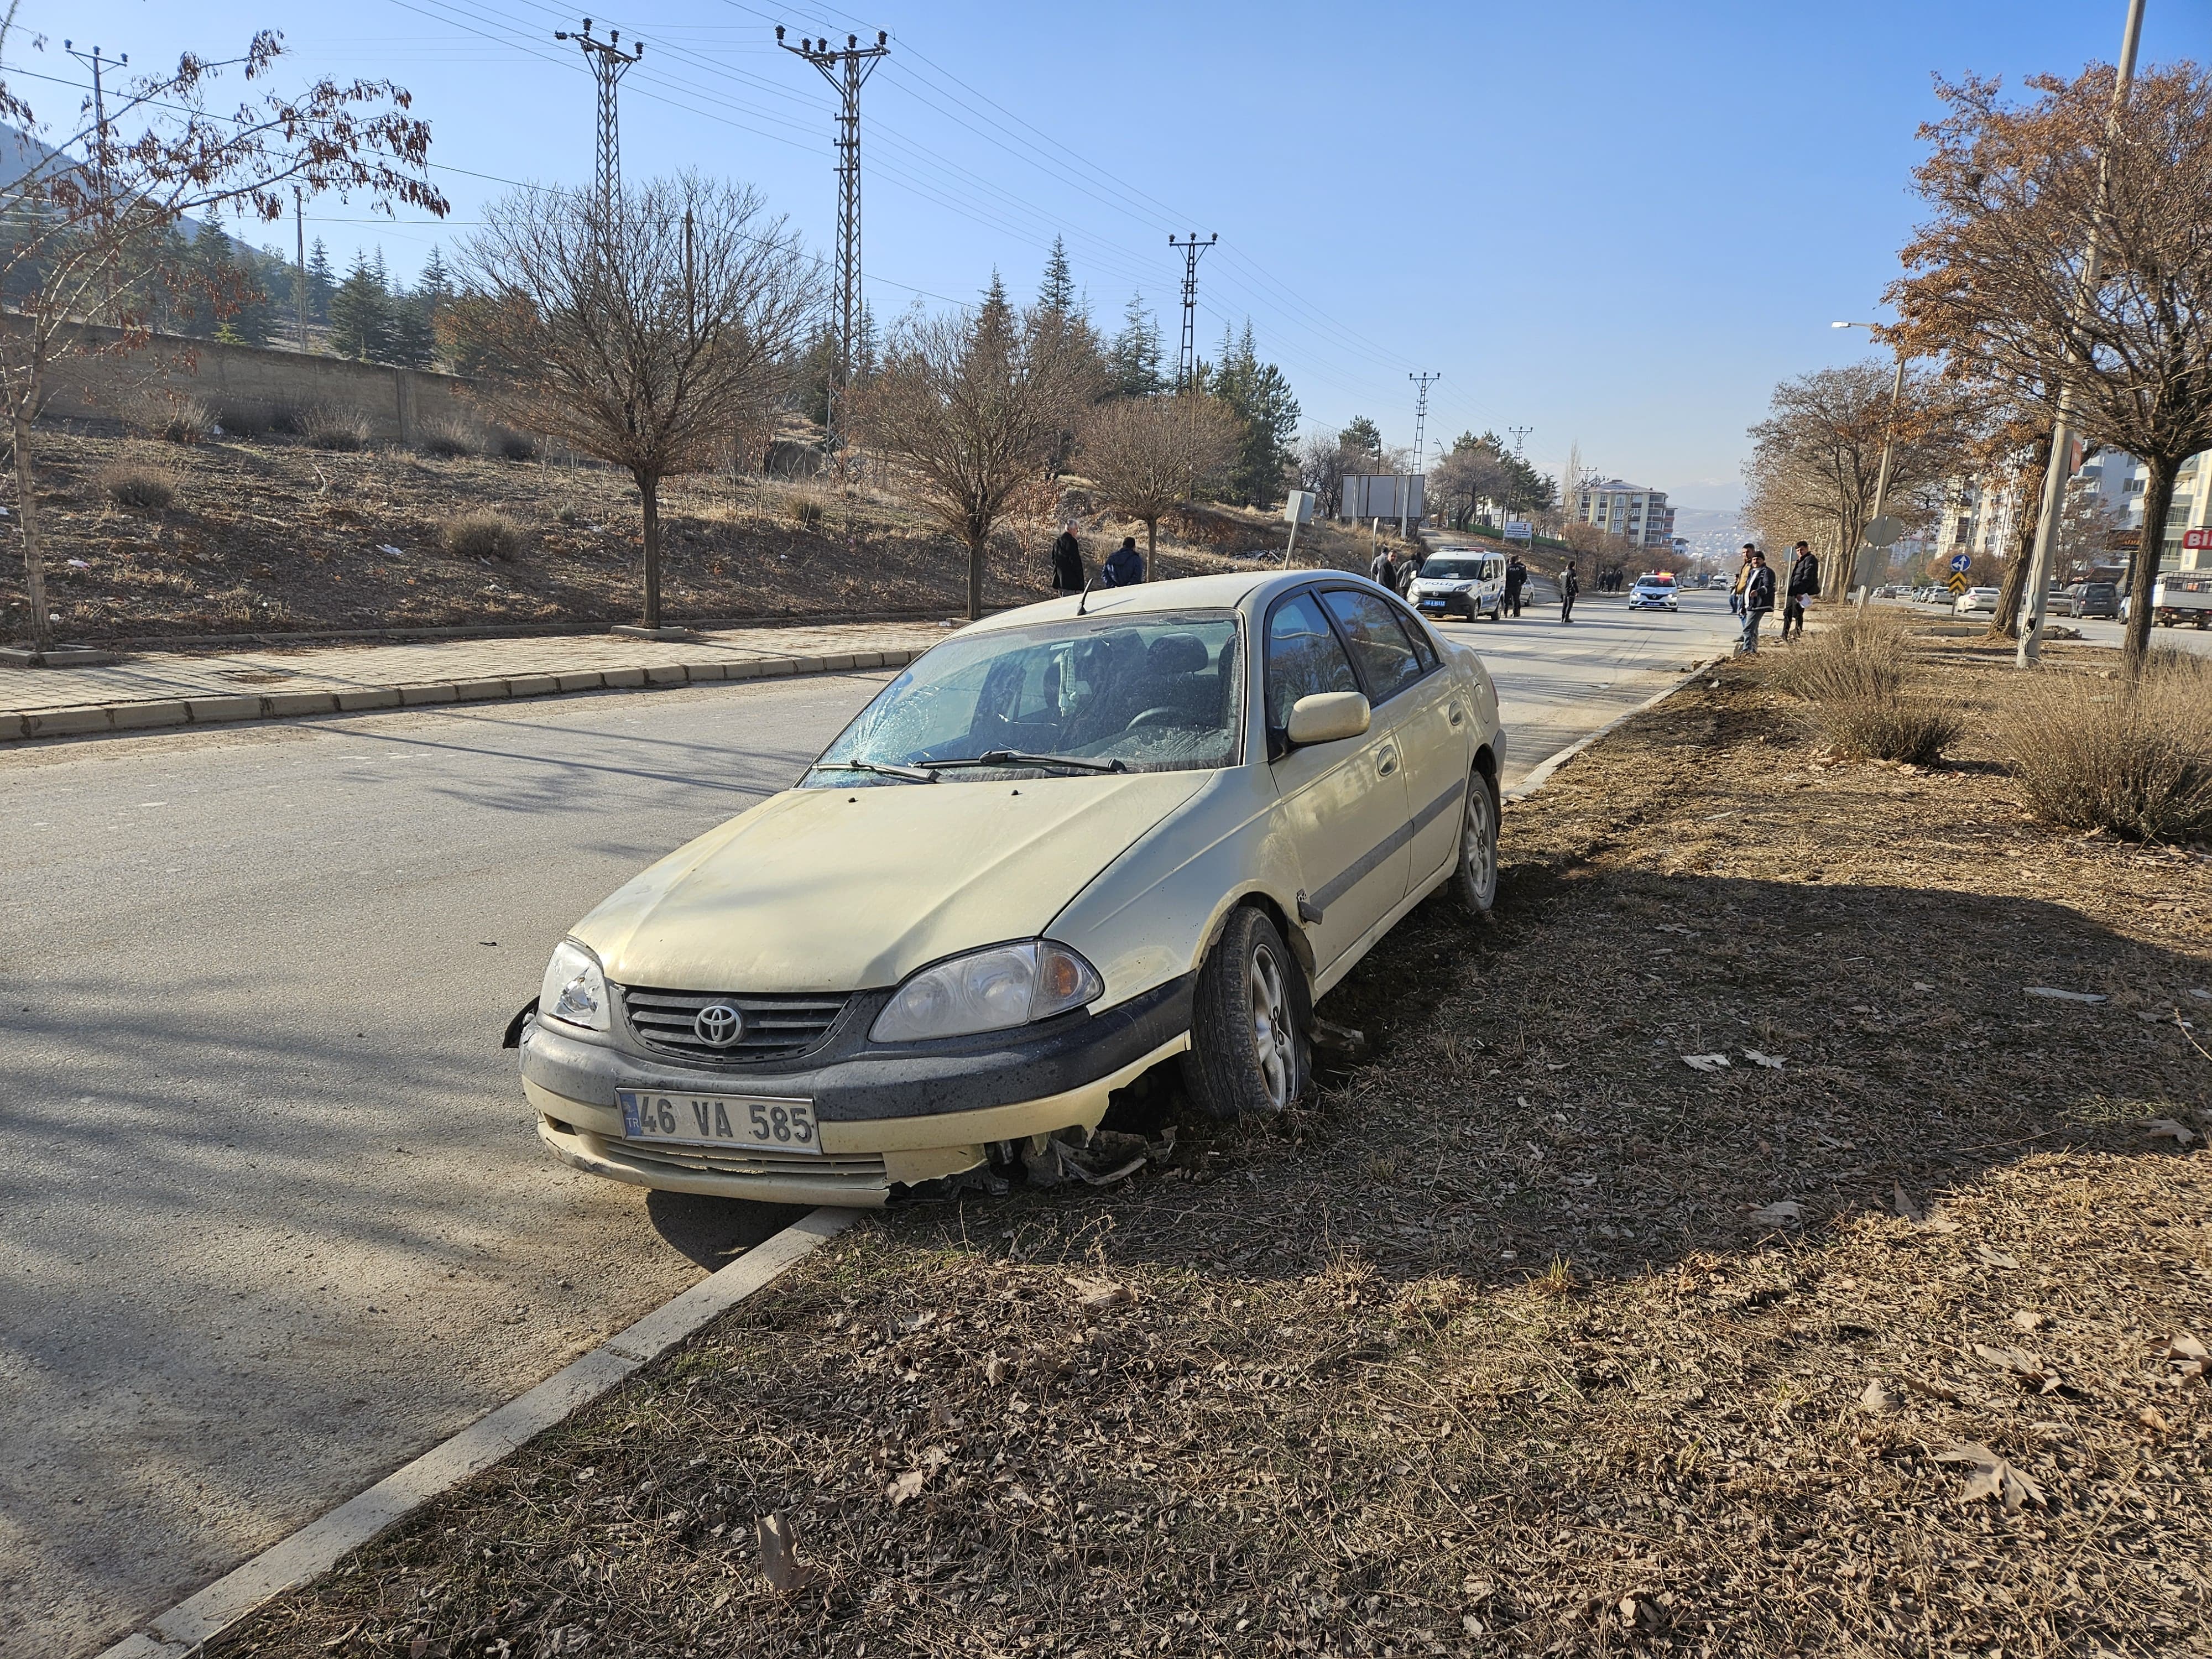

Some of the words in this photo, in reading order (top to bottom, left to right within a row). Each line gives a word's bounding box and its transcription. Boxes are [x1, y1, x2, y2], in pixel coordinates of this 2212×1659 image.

[2188, 530, 2212, 546] Bİ
[626, 1118, 639, 1128] TR
[640, 1097, 676, 1134] 46
[692, 1101, 733, 1138] VA
[749, 1105, 812, 1144] 585
